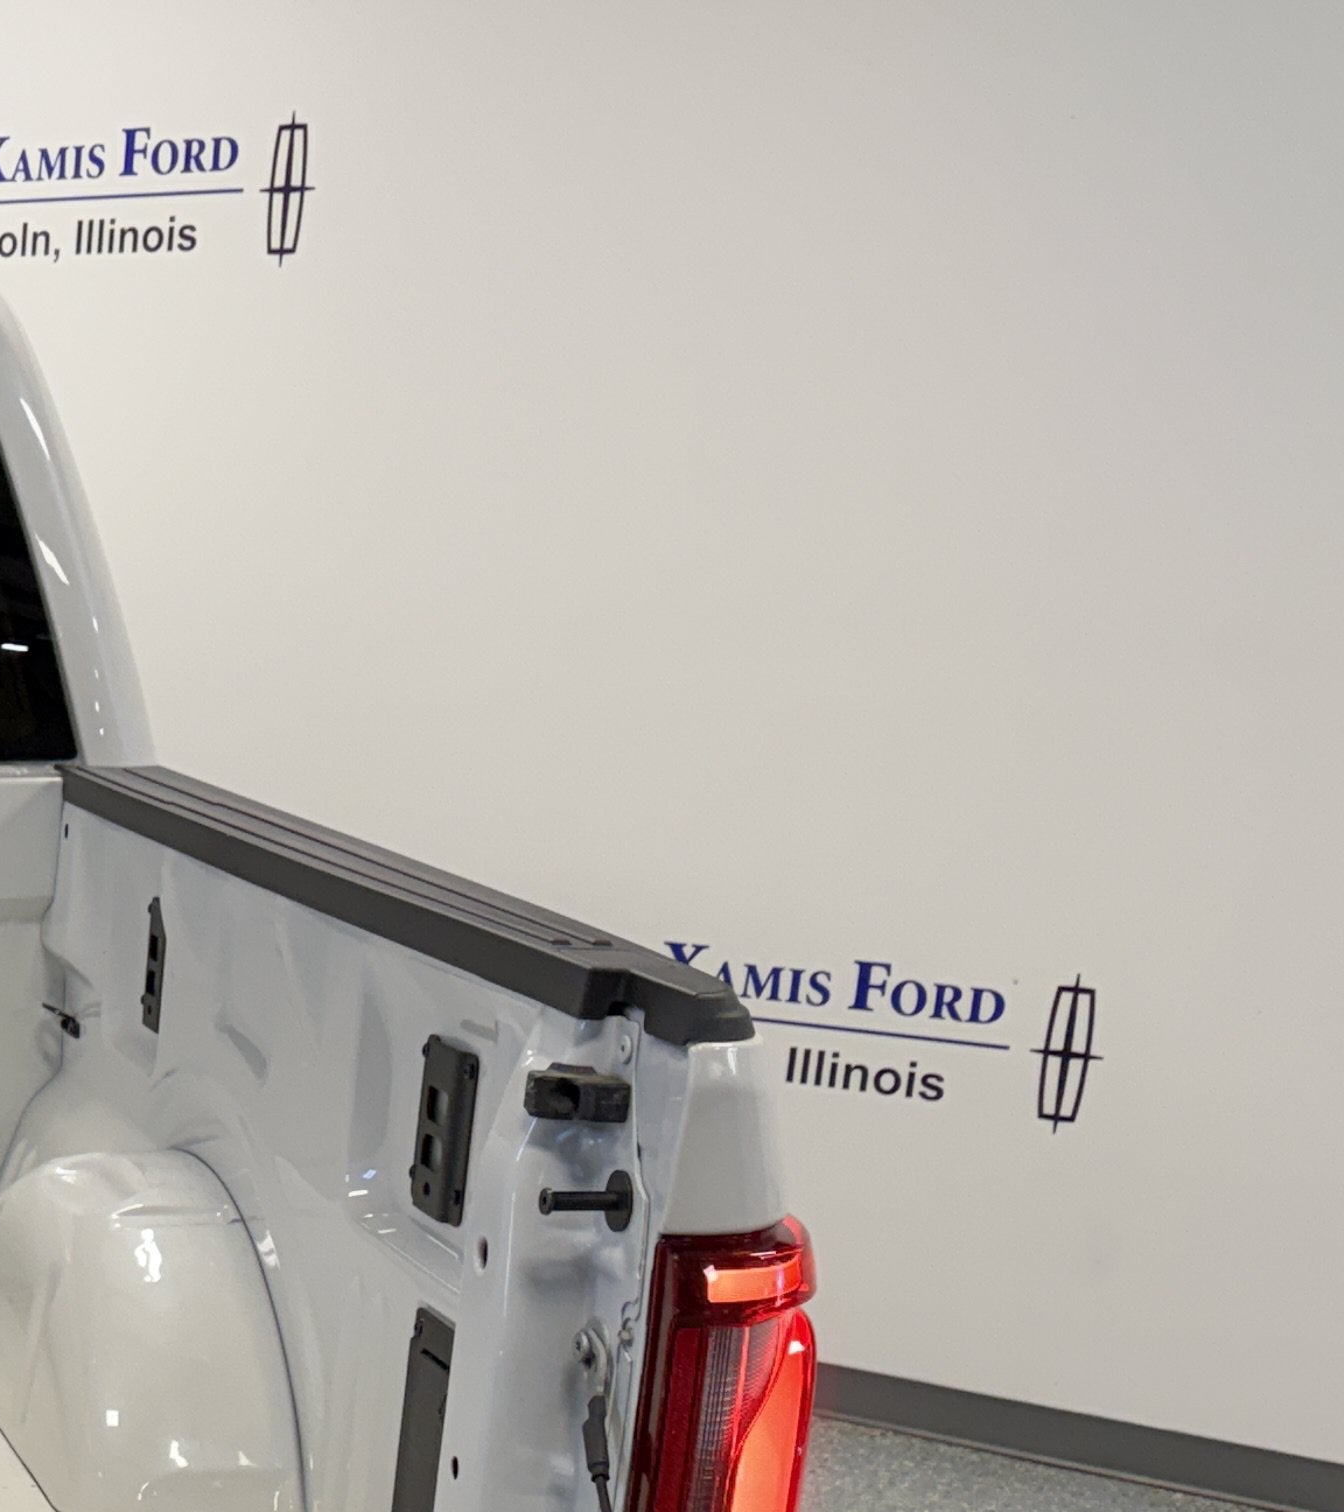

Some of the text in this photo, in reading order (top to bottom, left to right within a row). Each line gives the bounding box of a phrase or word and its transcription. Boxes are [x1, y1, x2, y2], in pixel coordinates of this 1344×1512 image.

[119, 127, 239, 176] FORD
[75, 215, 197, 256] Illinois
[847, 960, 1006, 1025] FORD
[784, 1047, 946, 1101] Illinois
